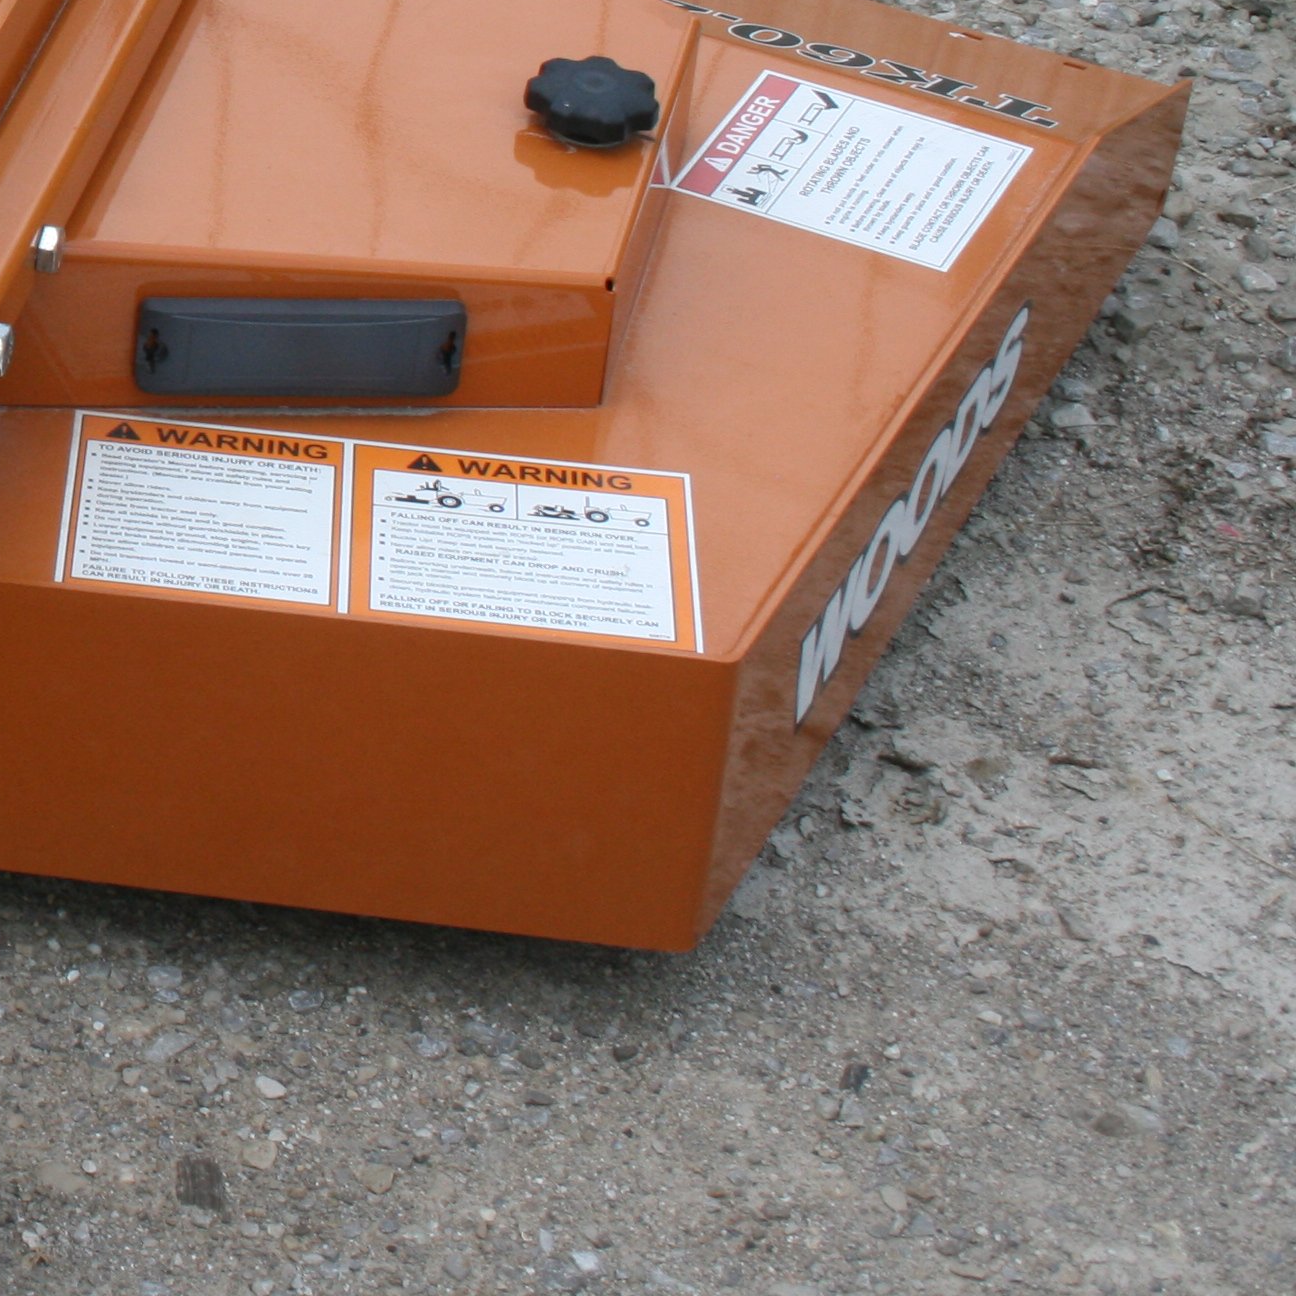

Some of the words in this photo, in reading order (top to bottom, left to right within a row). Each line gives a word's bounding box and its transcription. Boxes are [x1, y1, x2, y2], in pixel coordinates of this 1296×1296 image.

[716, 94, 781, 155] DANGER
[798, 163, 831, 197] ROTATING
[822, 138, 851, 166] BLADES
[841, 125, 861, 141] AND
[820, 165, 850, 194] THROWN
[840, 136, 871, 167] OBJECTS
[98, 443, 115, 451] TO
[116, 445, 154, 456] AVOID
[154, 449, 209, 461] SERIOUS
[210, 455, 255, 466] INJURY
[256, 460, 276, 468] OR
[156, 427, 328, 460] WARNING
[457, 458, 632, 491] WARNING
[390, 511, 436, 521] FALLING
[437, 516, 459, 524] OFF
[460, 518, 484, 526] CAN
[486, 521, 529, 531] RESULT
[543, 527, 577, 536] BEING
[578, 531, 603, 539] RUN
[795, 300, 1033, 732] WOODS
[395, 547, 435, 557] RAISED
[437, 552, 500, 564] EQUIPMENT
[501, 559, 526, 567] CAN
[527, 561, 559, 571] DROP
[560, 565, 585, 573] AND
[81, 569, 105, 577] CAN
[105, 572, 148, 582] RESULT
[162, 578, 202, 588] INJURY
[202, 582, 220, 590] OR
[82, 563, 128, 573] FAILURE
[150, 570, 195, 580] FOLLOW
[197, 575, 236, 585] THESE
[239, 580, 318, 594] INSTRUCTIONS
[379, 592, 426, 603] FALLING
[427, 597, 450, 605] OFF
[470, 602, 514, 612] FAILING
[533, 608, 573, 619] BLOCK
[574, 613, 634, 625] SECURELY
[635, 619, 659, 628] CAN
[379, 599, 423, 610] RESULT
[437, 606, 487, 617] SERIOUS
[488, 611, 529, 621] INJURY
